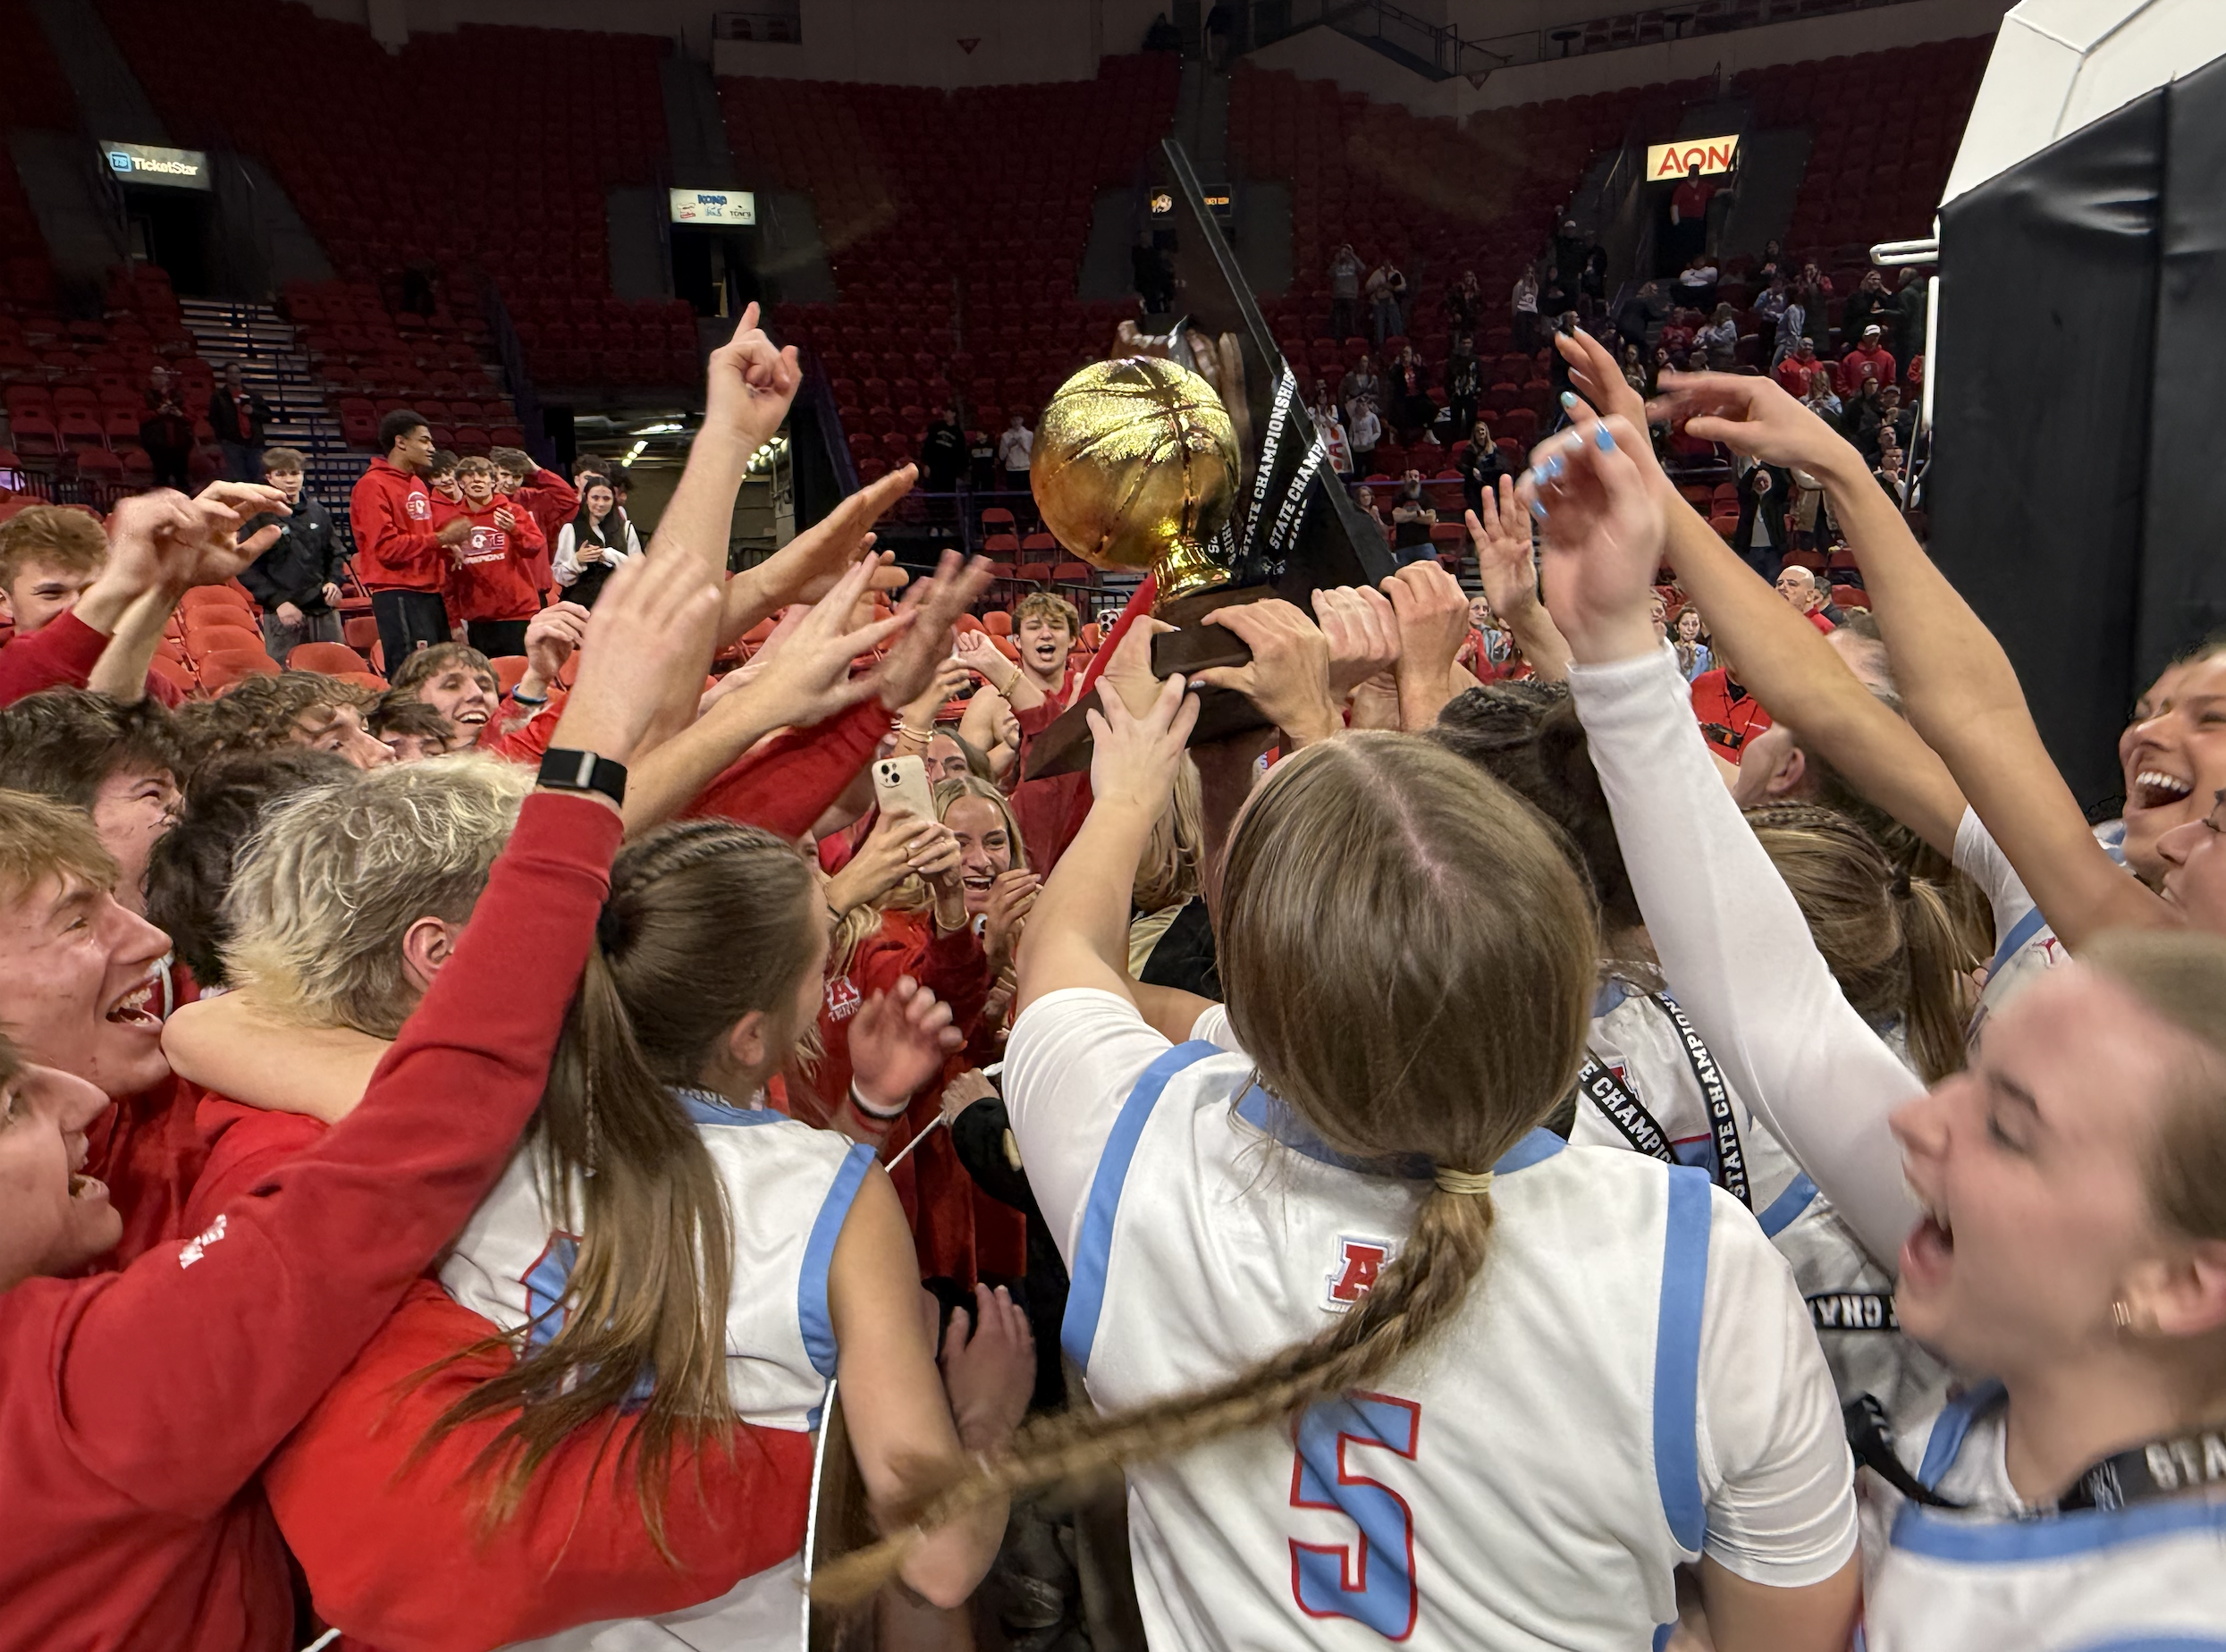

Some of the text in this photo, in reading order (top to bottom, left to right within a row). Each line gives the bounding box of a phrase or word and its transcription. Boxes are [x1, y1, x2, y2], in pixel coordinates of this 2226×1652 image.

[131, 156, 198, 176] TicketStar
[1657, 144, 1730, 176] AON
[1269, 499, 1296, 551] STATE
[1717, 1121, 1746, 1198] STATE
[1329, 1238, 1395, 1308] A
[1288, 1388, 1421, 1643] 5
